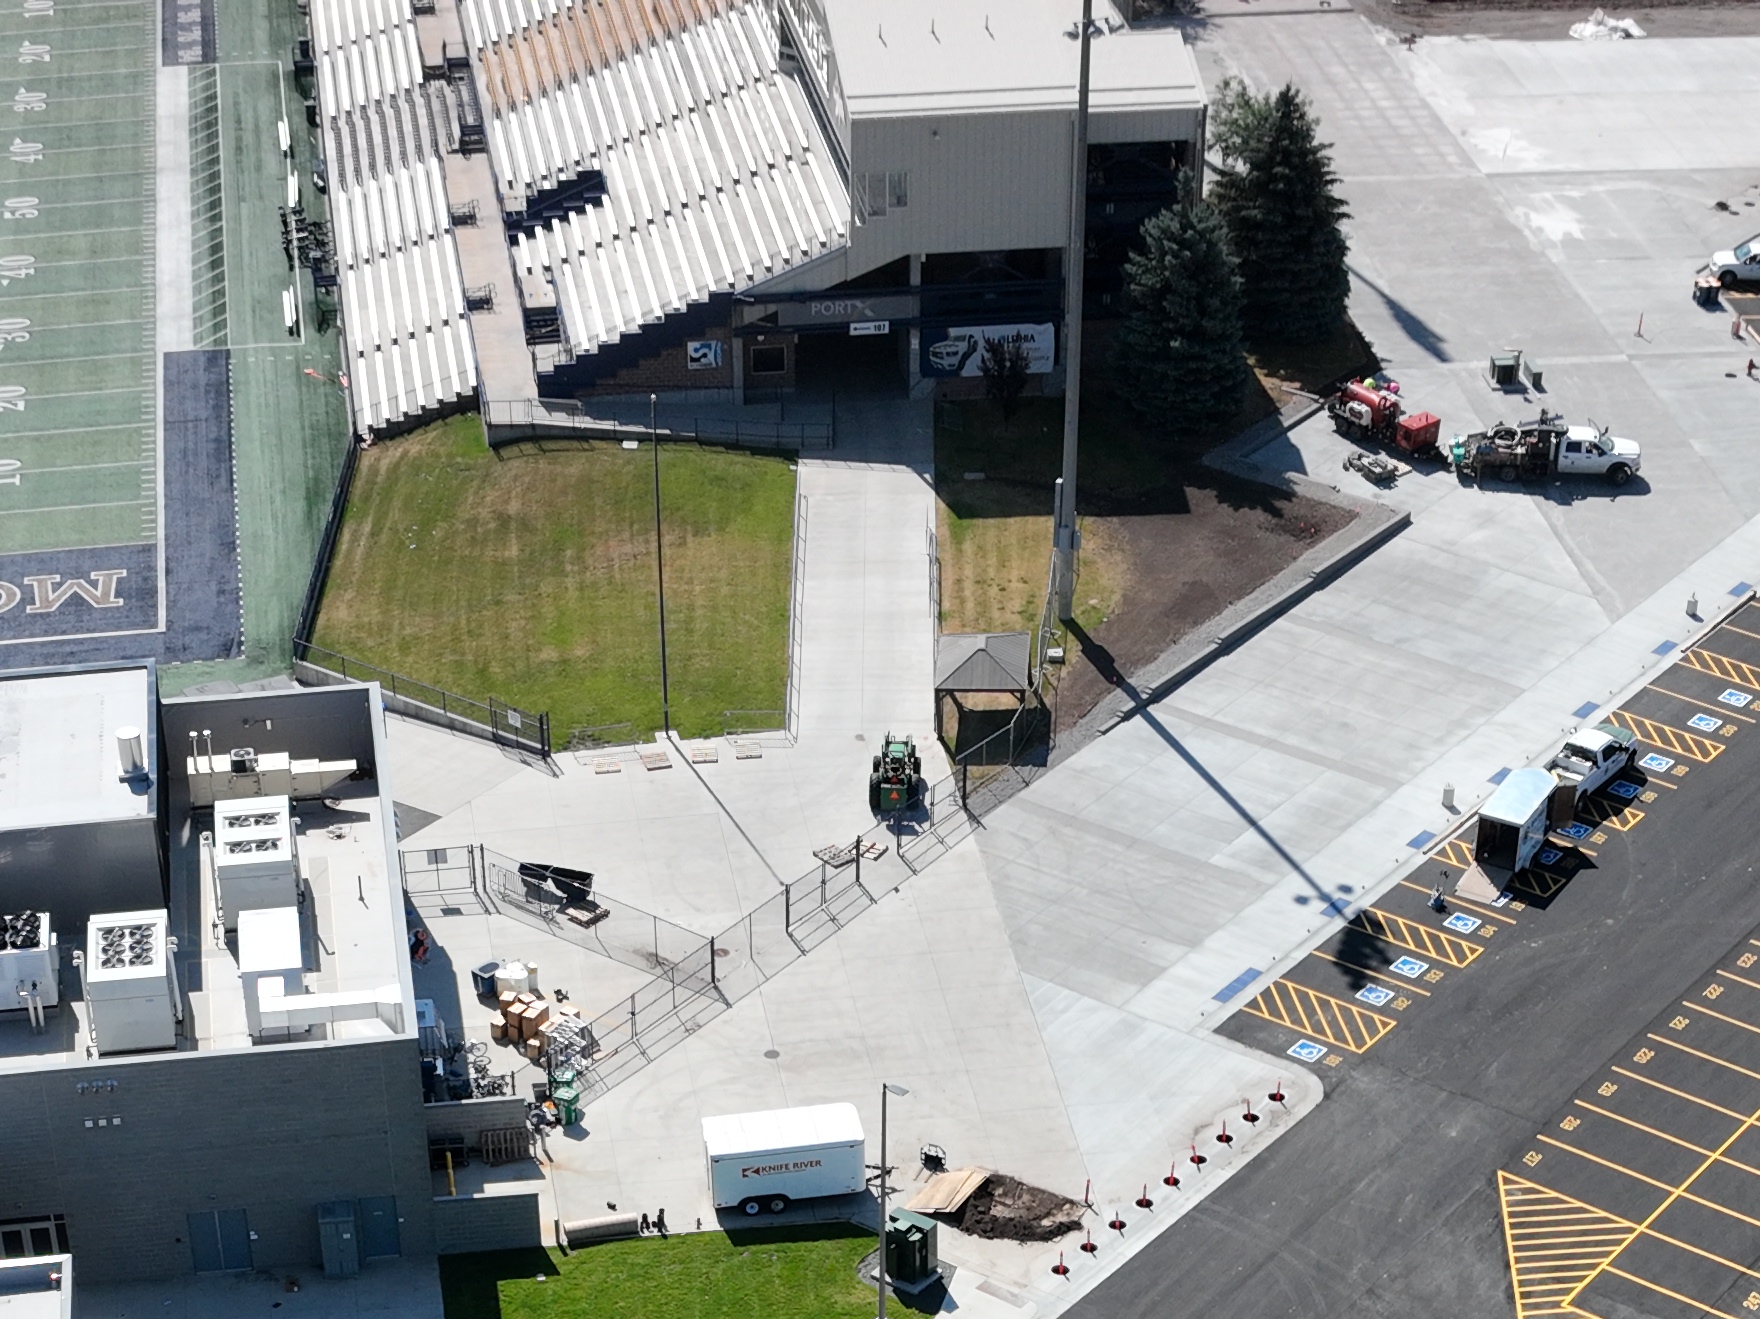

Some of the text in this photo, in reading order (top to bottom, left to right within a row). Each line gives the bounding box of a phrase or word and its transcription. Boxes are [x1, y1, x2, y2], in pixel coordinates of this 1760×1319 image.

[18, 45, 51, 64] 20
[13, 92, 47, 112] 30
[9, 143, 43, 164] 40
[3, 197, 39, 219] 50
[872, 323, 886, 331] 107
[761, 1163, 790, 1173] KNIFE
[792, 1159, 823, 1169] RIVER
